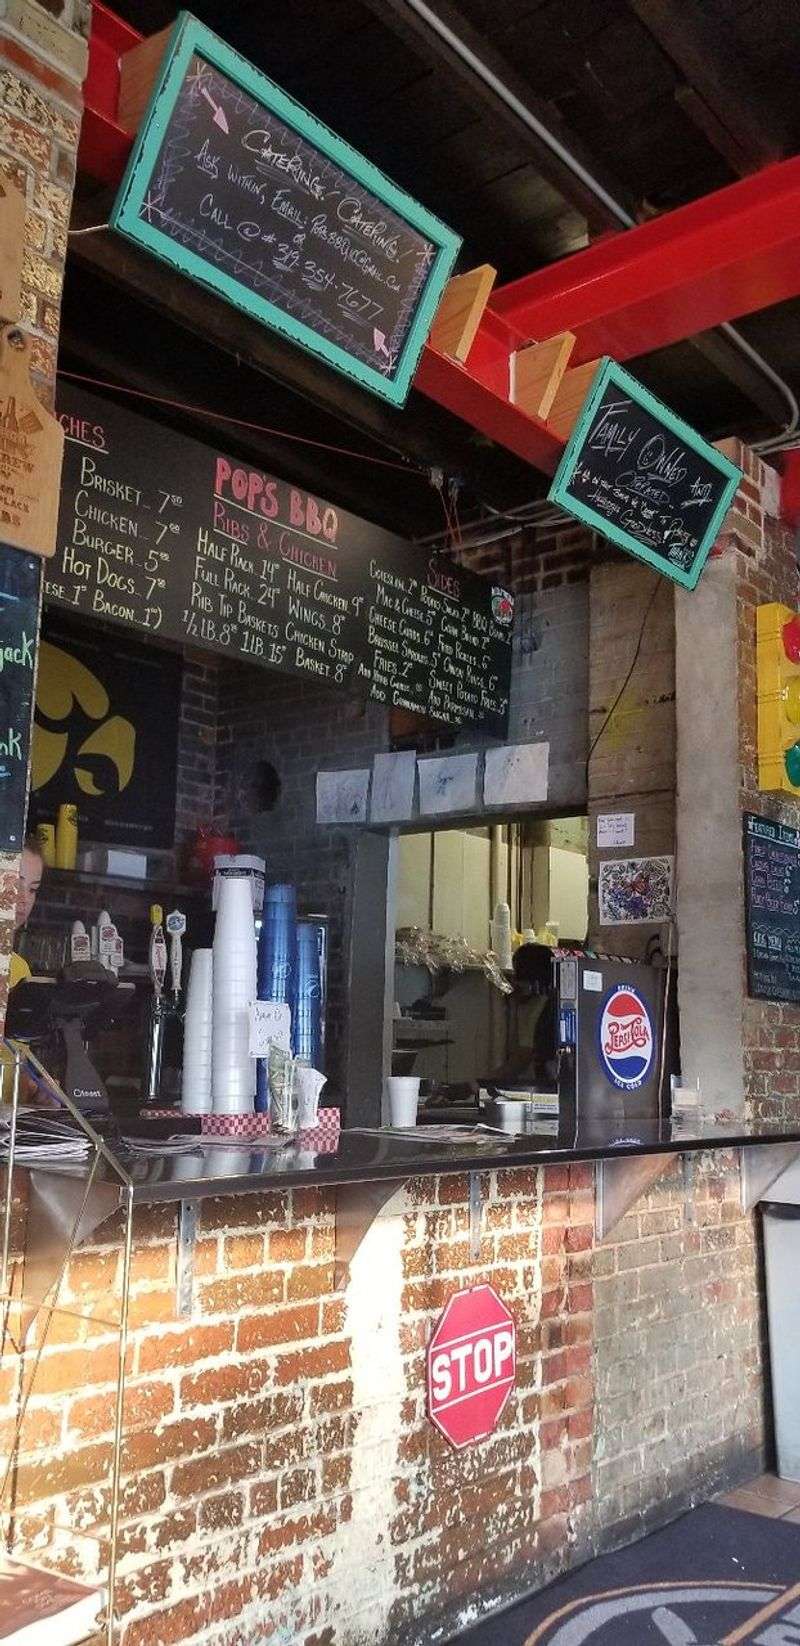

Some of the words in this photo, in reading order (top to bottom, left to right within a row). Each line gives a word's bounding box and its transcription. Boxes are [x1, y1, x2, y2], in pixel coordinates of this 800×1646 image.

[199, 193, 233, 230] CALL
[588, 400, 641, 463] FAMILY
[80, 456, 143, 507] BRISKET
[214, 457, 279, 518] POP'S
[289, 488, 338, 543] BBQ
[74, 489, 139, 538] CHICKEN
[72, 518, 134, 566] BURGER
[197, 526, 227, 563] HALF
[230, 543, 255, 575] RACK
[213, 500, 249, 543] RIBS
[257, 521, 270, 550] &
[279, 530, 337, 578] CHICKEN
[62, 546, 92, 580] HOT
[97, 556, 137, 595] DOGS
[194, 556, 220, 587] FULL
[224, 567, 251, 599] RACK
[287, 568, 311, 598] HALF
[313, 579, 349, 614] CHICKEN
[92, 589, 136, 622] BACON
[191, 581, 214, 613] RIB
[217, 594, 234, 618] TIP
[238, 600, 280, 638] BASKETS
[288, 596, 326, 630] WINGS
[285, 622, 326, 653] CHICKEN
[295, 646, 331, 677] BASKET
[432, 1331, 513, 1401] STOP
